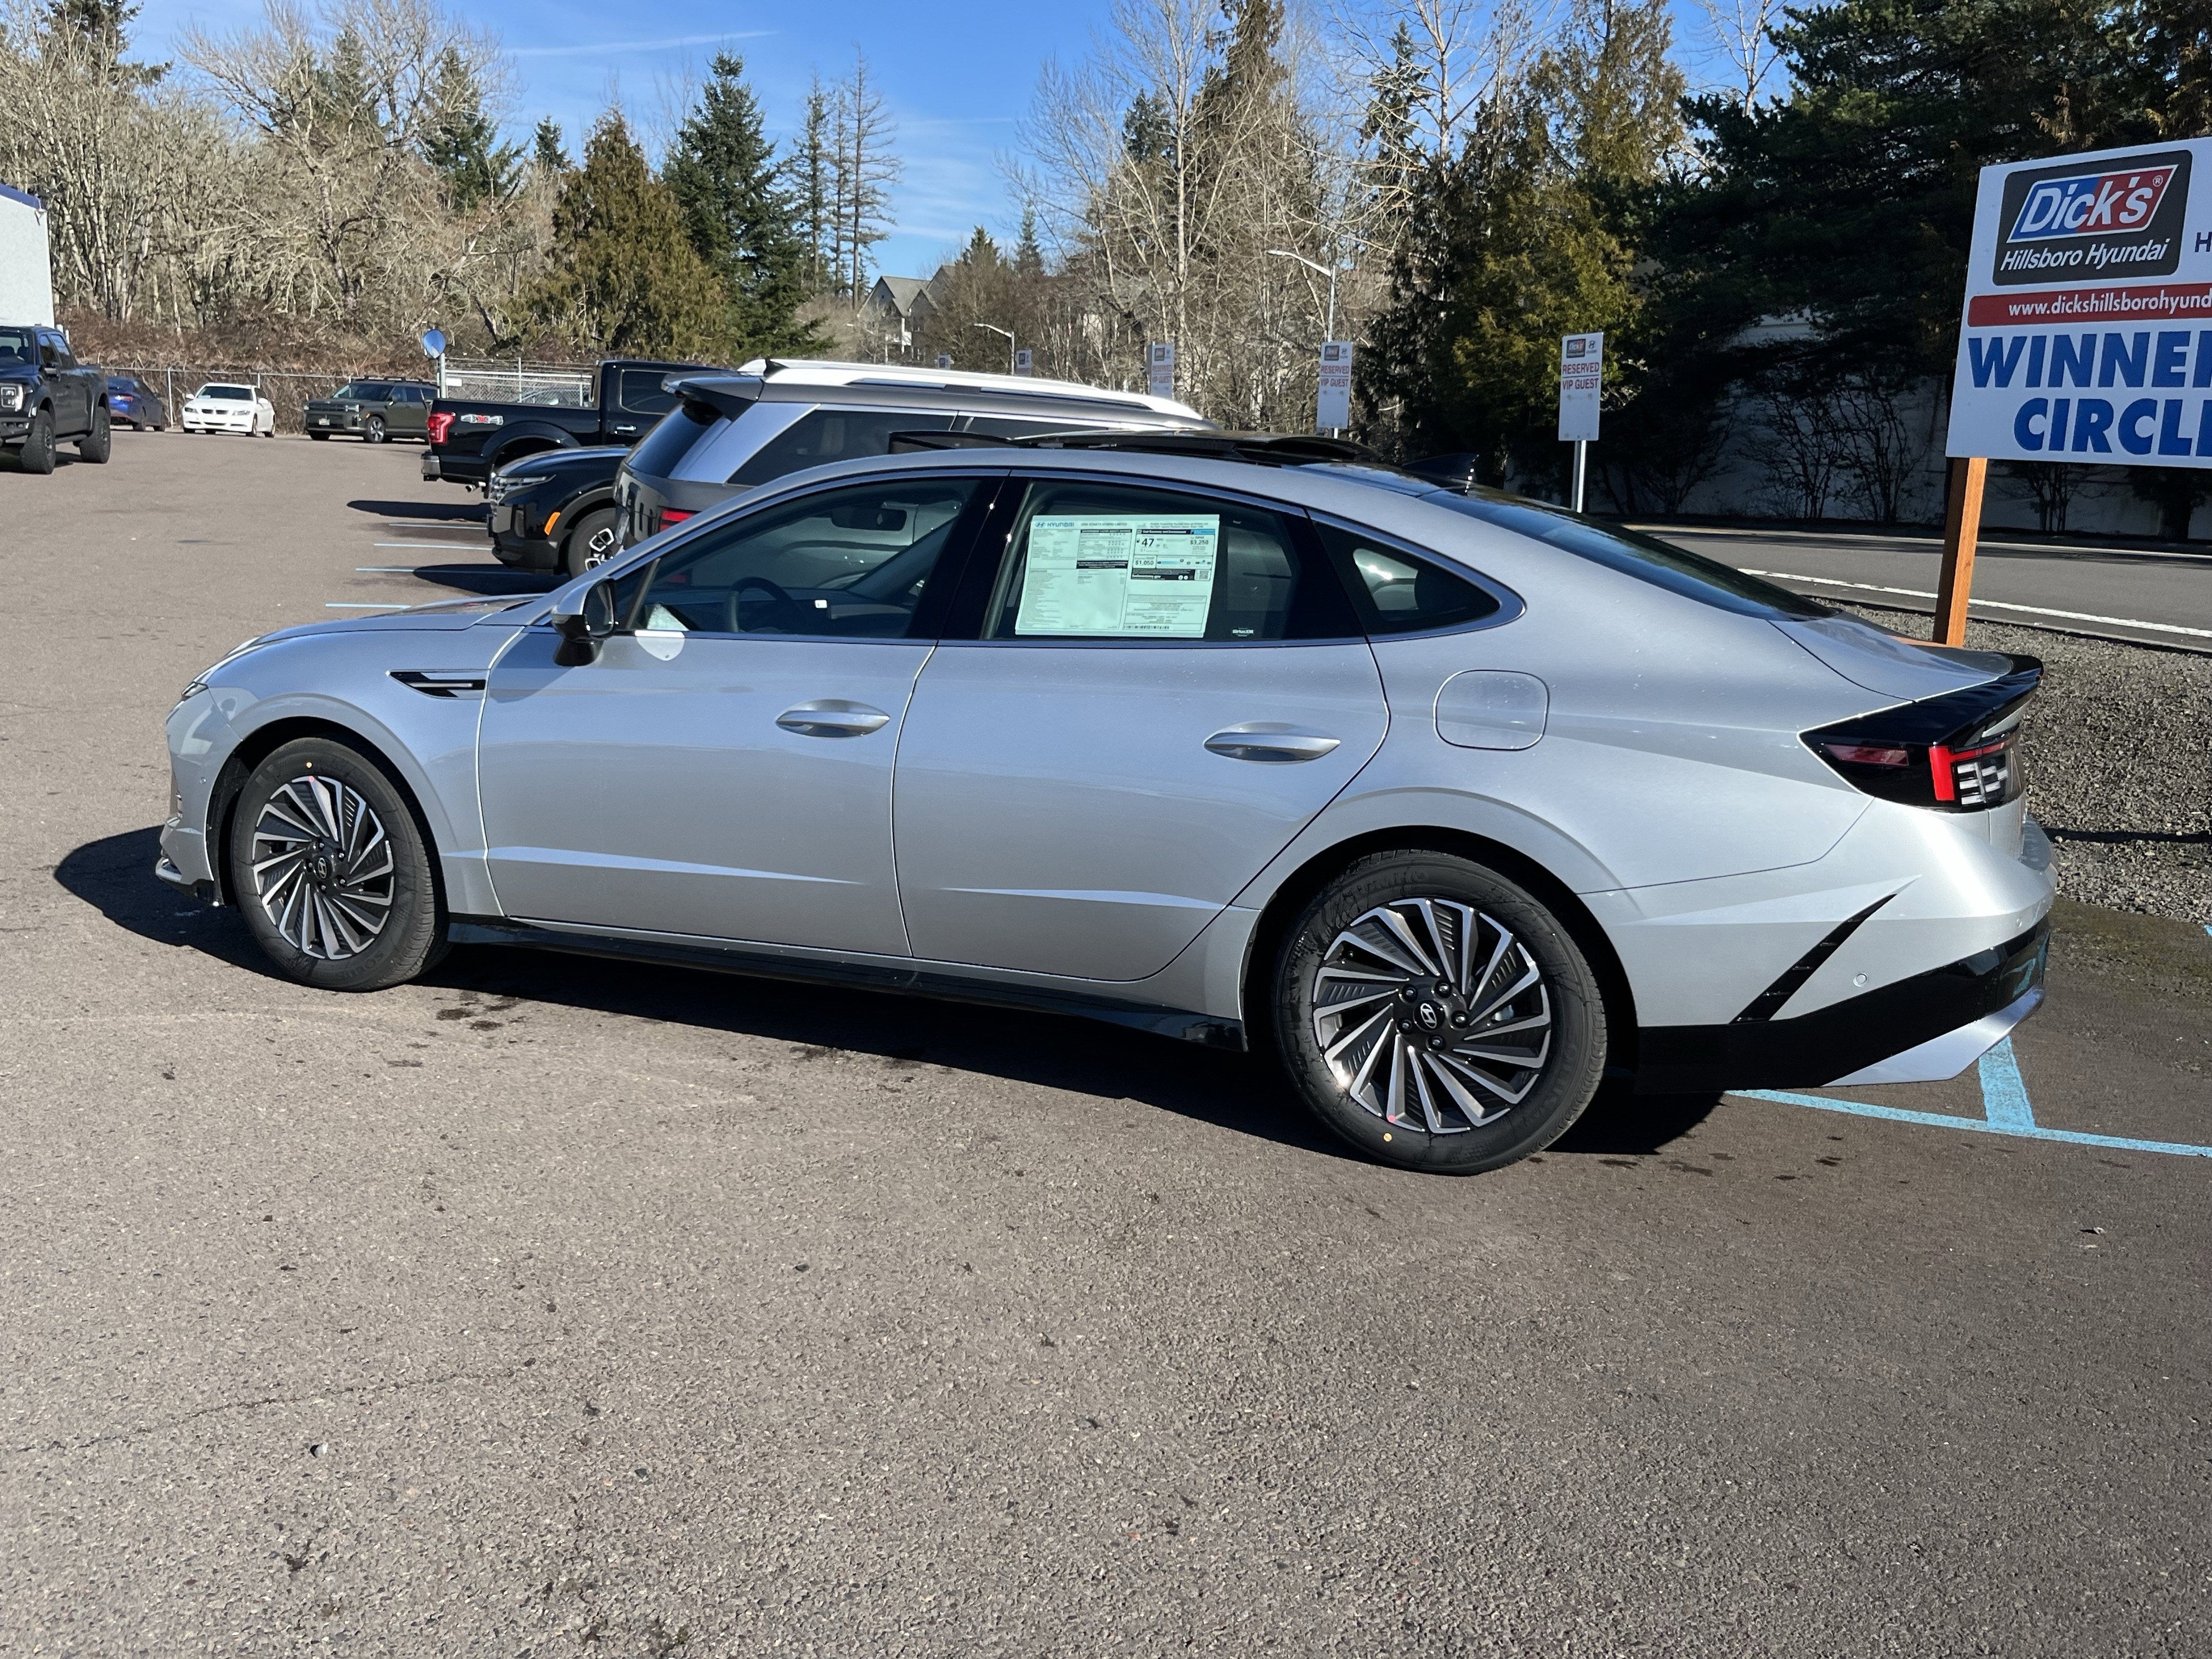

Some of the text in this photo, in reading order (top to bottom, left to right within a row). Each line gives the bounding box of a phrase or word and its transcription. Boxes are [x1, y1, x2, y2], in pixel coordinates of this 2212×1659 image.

[2000, 238, 2170, 271] Hillsboro Hyundai
[1321, 365, 1350, 374] RESERVED
[1562, 362, 1599, 374] RESERVED
[1330, 378, 1348, 387] GUEST
[1562, 378, 1599, 390] VIP GUEST
[1141, 538, 1154, 547] 47
